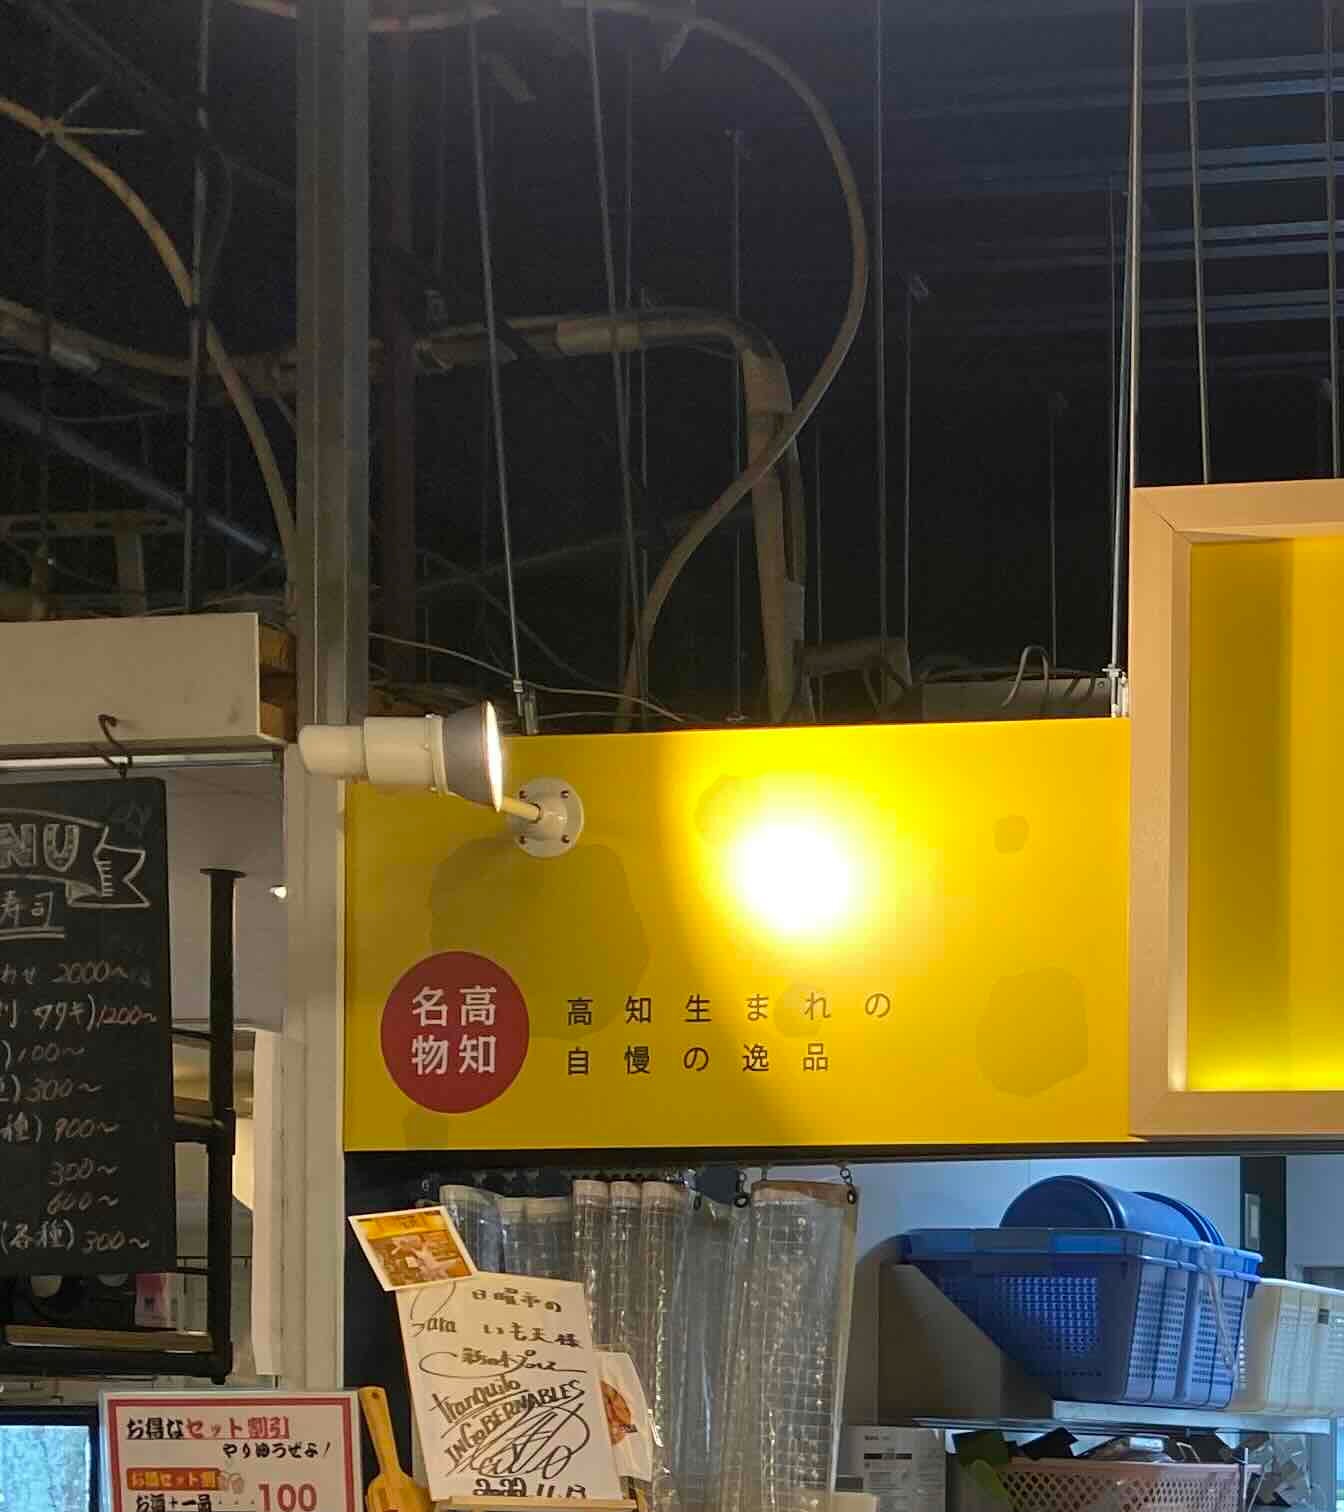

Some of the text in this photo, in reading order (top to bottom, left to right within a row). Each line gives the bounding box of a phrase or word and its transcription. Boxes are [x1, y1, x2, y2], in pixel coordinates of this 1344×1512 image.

[566, 990, 893, 1027] 高知生まれの
[566, 1042, 830, 1077] 自慢の逸品
[126, 1415, 290, 1440] お得なセット割引
[258, 1483, 318, 1512] 100
